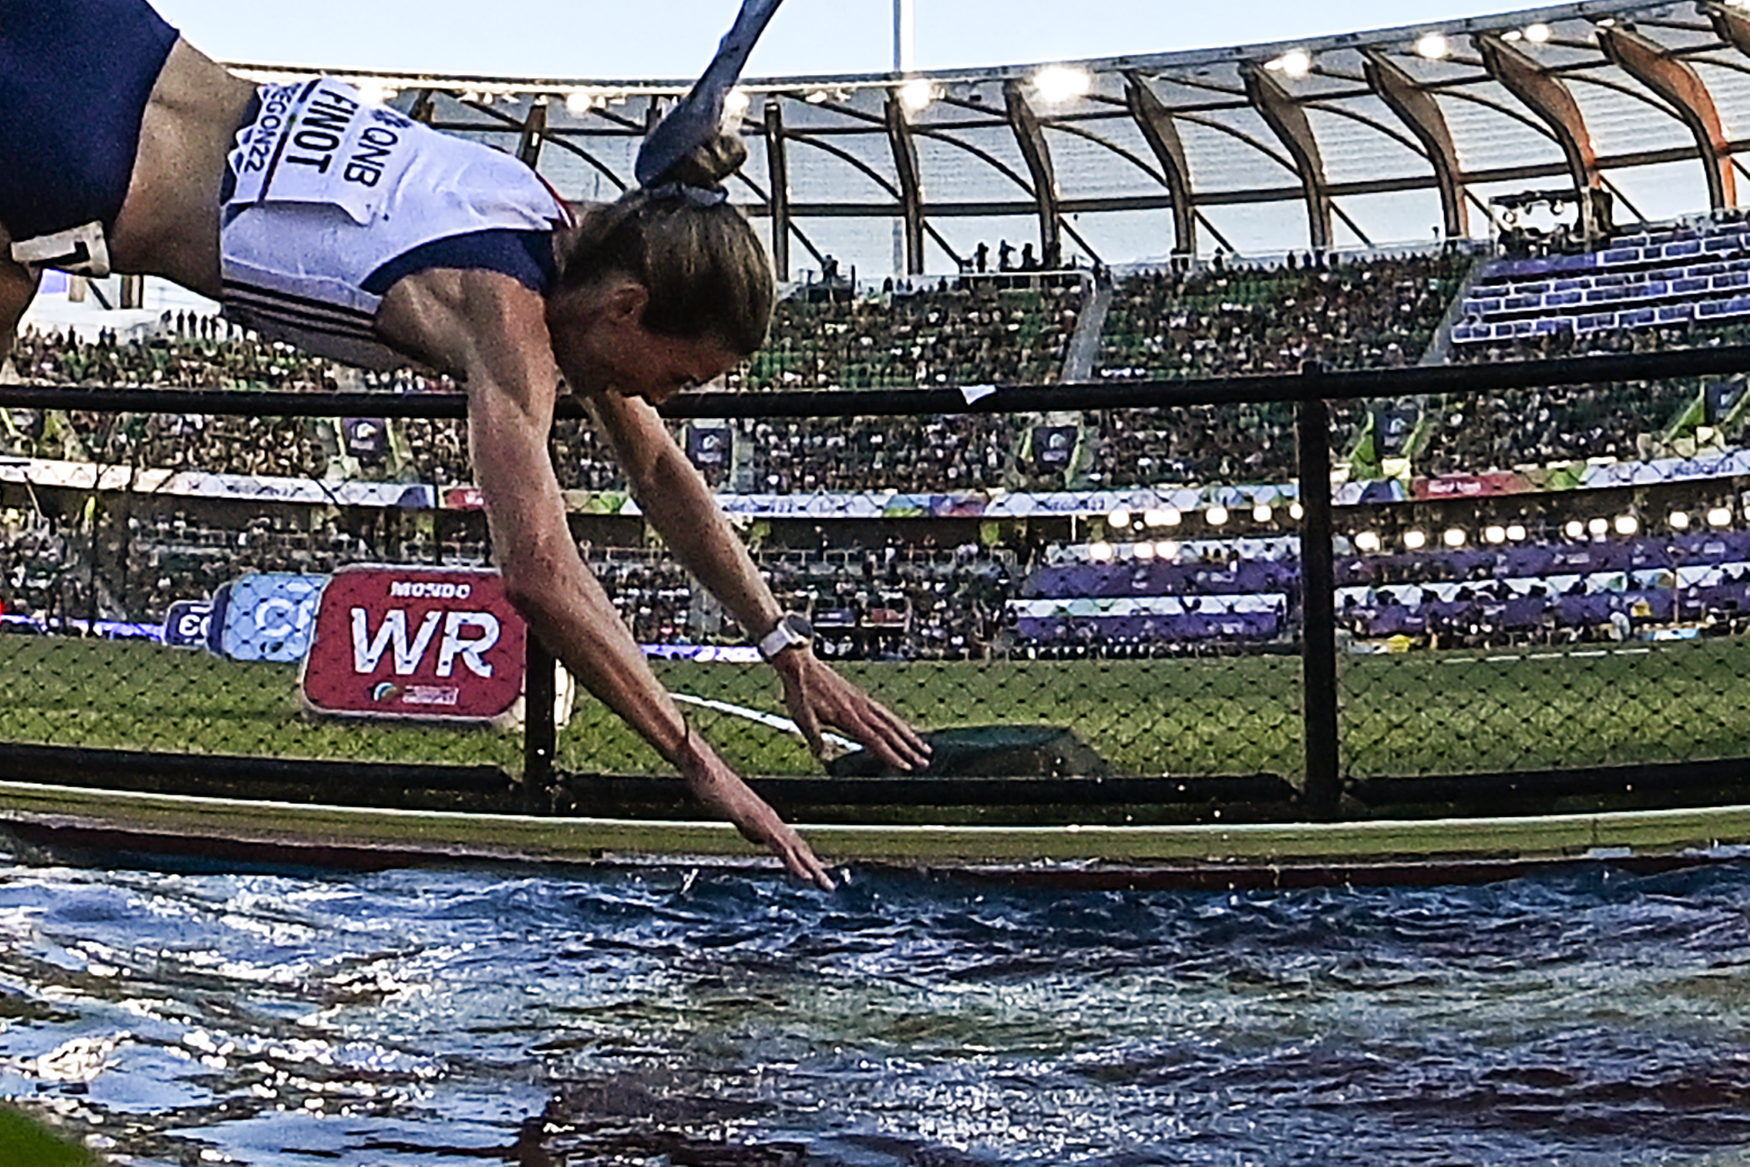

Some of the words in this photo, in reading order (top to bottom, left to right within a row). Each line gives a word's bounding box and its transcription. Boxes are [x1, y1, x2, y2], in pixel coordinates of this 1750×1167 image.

[286, 88, 359, 174] FINOT
[344, 127, 398, 188] QNB
[391, 581, 471, 599] MONDO
[350, 607, 501, 678] WR
